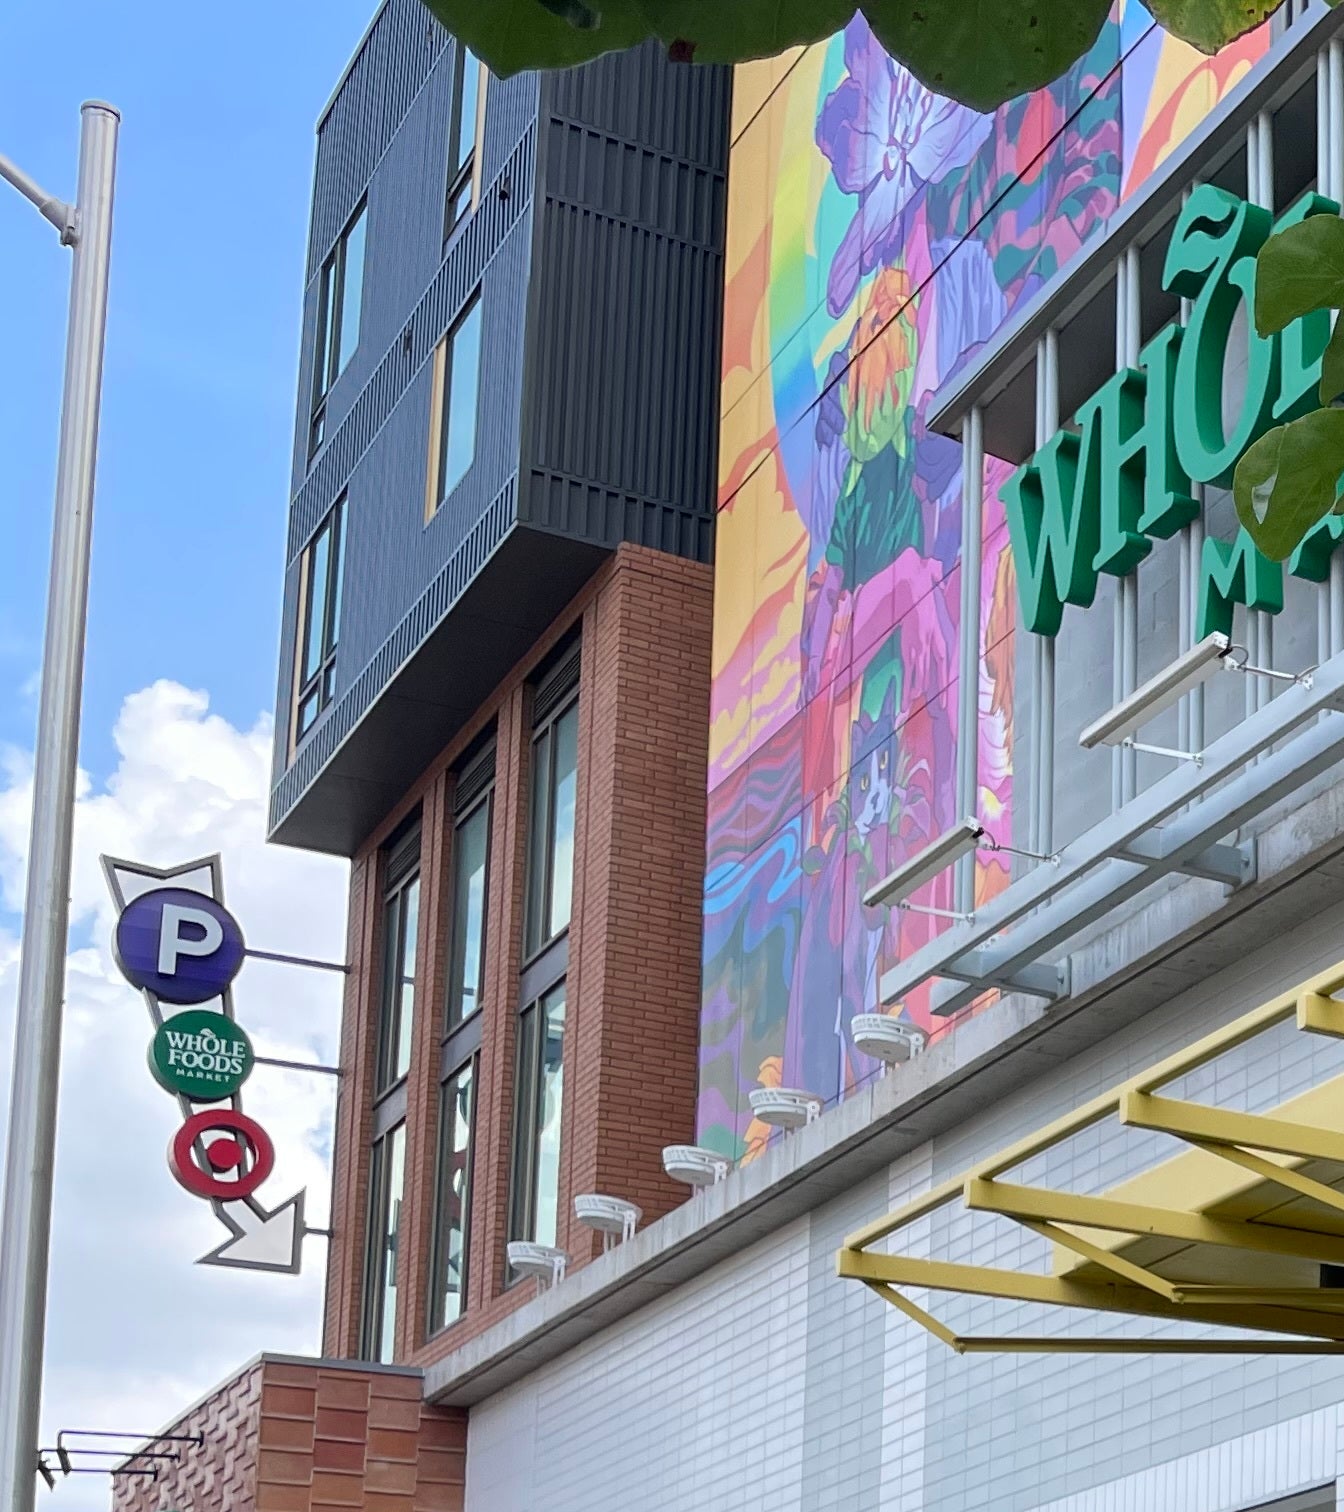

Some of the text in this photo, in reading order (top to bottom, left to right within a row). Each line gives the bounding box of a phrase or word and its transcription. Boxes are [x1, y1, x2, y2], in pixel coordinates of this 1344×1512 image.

[157, 903, 224, 975] P
[165, 1028, 246, 1059] WHOLE
[168, 1049, 243, 1075] FOODS
[175, 1068, 231, 1083] MARKET
